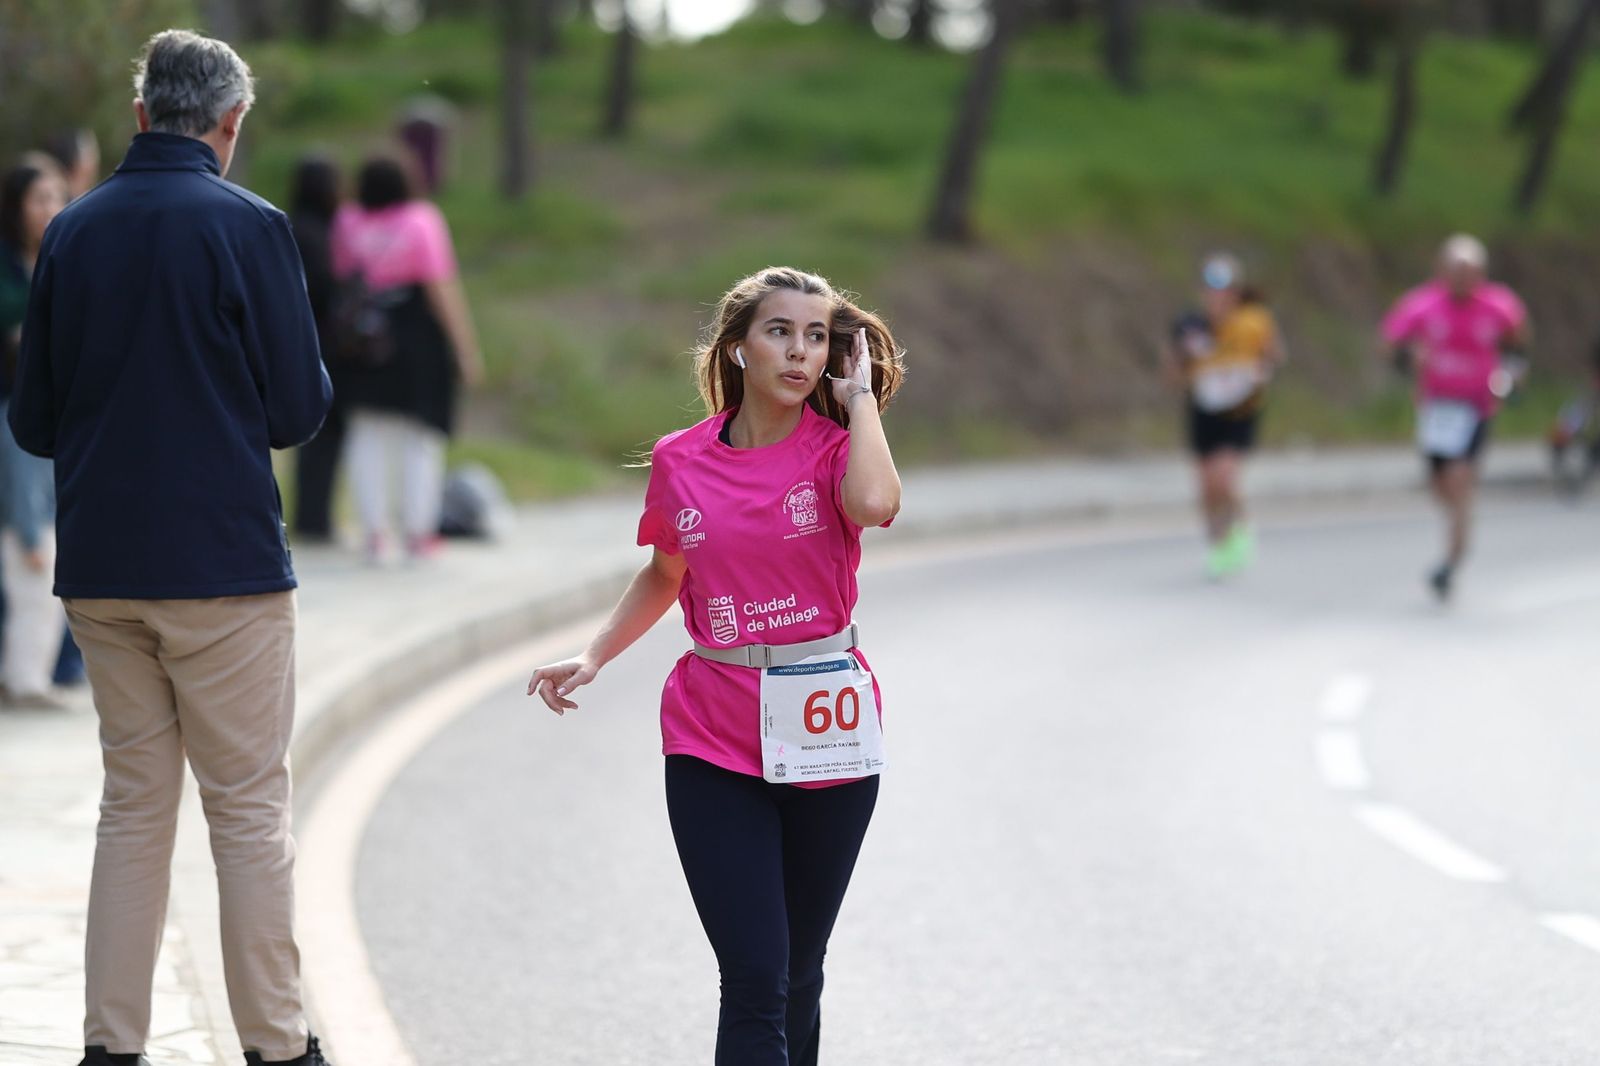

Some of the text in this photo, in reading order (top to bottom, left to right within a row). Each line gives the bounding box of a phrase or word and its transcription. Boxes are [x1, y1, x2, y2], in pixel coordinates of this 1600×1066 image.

[743, 593, 797, 616] Ciudad
[746, 606, 820, 632] de Málaga
[779, 663, 840, 673] www.deporte.malaga.es
[803, 686, 860, 735] 60
